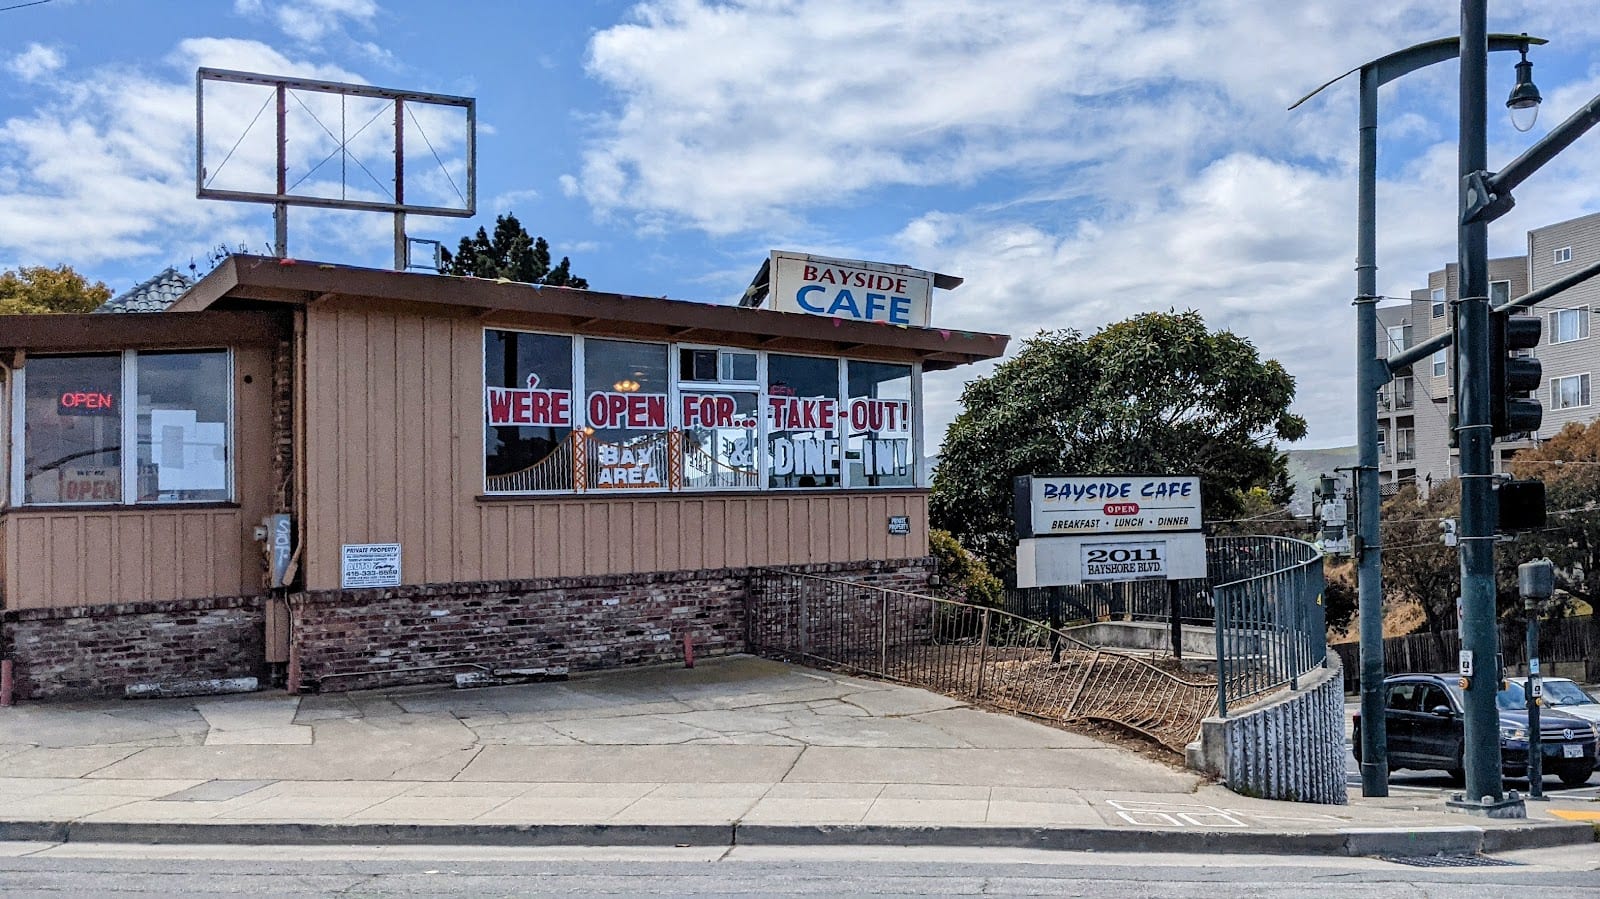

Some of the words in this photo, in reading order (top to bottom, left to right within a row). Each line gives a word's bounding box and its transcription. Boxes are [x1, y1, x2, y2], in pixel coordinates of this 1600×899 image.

[803, 265, 908, 294] BAYSIDE
[796, 285, 911, 325] CAFE
[61, 392, 112, 408] OPEN
[488, 373, 572, 426] WE'RE
[588, 392, 668, 429] OPEN
[682, 394, 757, 429] FOR...
[601, 446, 653, 465] BAY
[729, 435, 754, 468] &
[598, 466, 660, 485] AREA
[66, 480, 117, 500] OPEN
[1043, 482, 1133, 502] BAYSIDE
[1140, 481, 1193, 500] CAFE
[1107, 505, 1136, 514] OPEN
[1051, 519, 1100, 530] BREAKFAST
[1114, 517, 1145, 528] LUNCH
[1157, 516, 1190, 527] DINNER
[1087, 548, 1162, 564] 2011
[346, 561, 372, 571] AUTO
[1087, 563, 1136, 575] BAYSHORE
[1137, 562, 1163, 573] BLVD.
